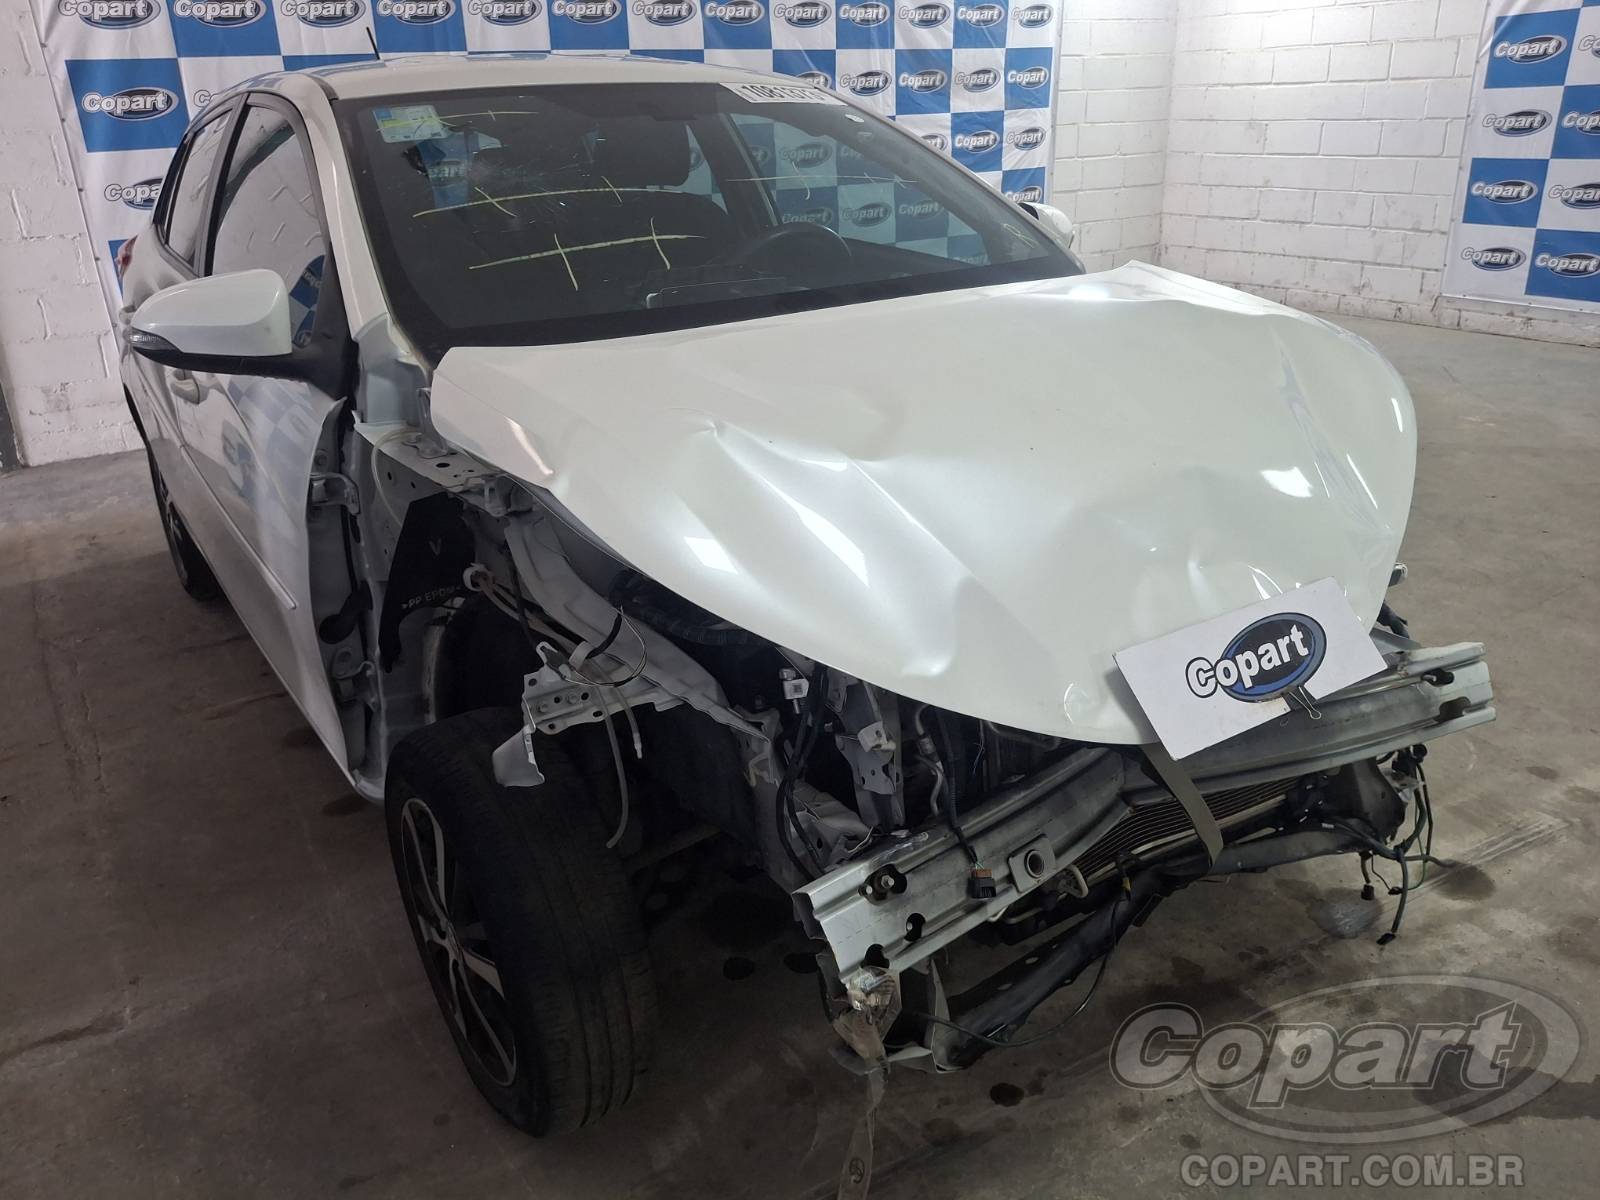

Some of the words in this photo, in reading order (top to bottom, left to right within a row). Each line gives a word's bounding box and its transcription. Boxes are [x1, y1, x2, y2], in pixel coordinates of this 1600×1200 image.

[59, 0, 148, 20] Copart
[174, 0, 255, 20] Copart
[281, 0, 355, 17] Copart
[377, 0, 451, 17] Copart
[467, 0, 532, 17] Copart
[552, 0, 613, 18] Copart
[632, 0, 688, 18] Copart
[704, 1, 759, 20] Copart
[773, 3, 825, 22] Copart
[839, 2, 884, 21] Copart
[899, 3, 944, 22] Copart
[957, 4, 999, 22] Copart
[1011, 4, 1049, 22] Copart
[1495, 40, 1559, 60] Copart
[840, 73, 889, 90] Copart
[899, 73, 942, 90] Copart
[954, 71, 994, 88] Copart
[1008, 70, 1046, 87] Copart
[83, 91, 168, 115] Copart
[1482, 113, 1542, 131] Copart
[1562, 112, 1600, 132] Cop
[955, 133, 996, 149] Copart
[1007, 131, 1044, 146] Copart
[104, 183, 160, 204] Copa
[1471, 182, 1530, 200] Copart
[899, 202, 940, 217] Copart
[1461, 247, 1516, 266] Copart
[1535, 253, 1597, 272] Copart
[1186, 624, 1310, 698] Copart
